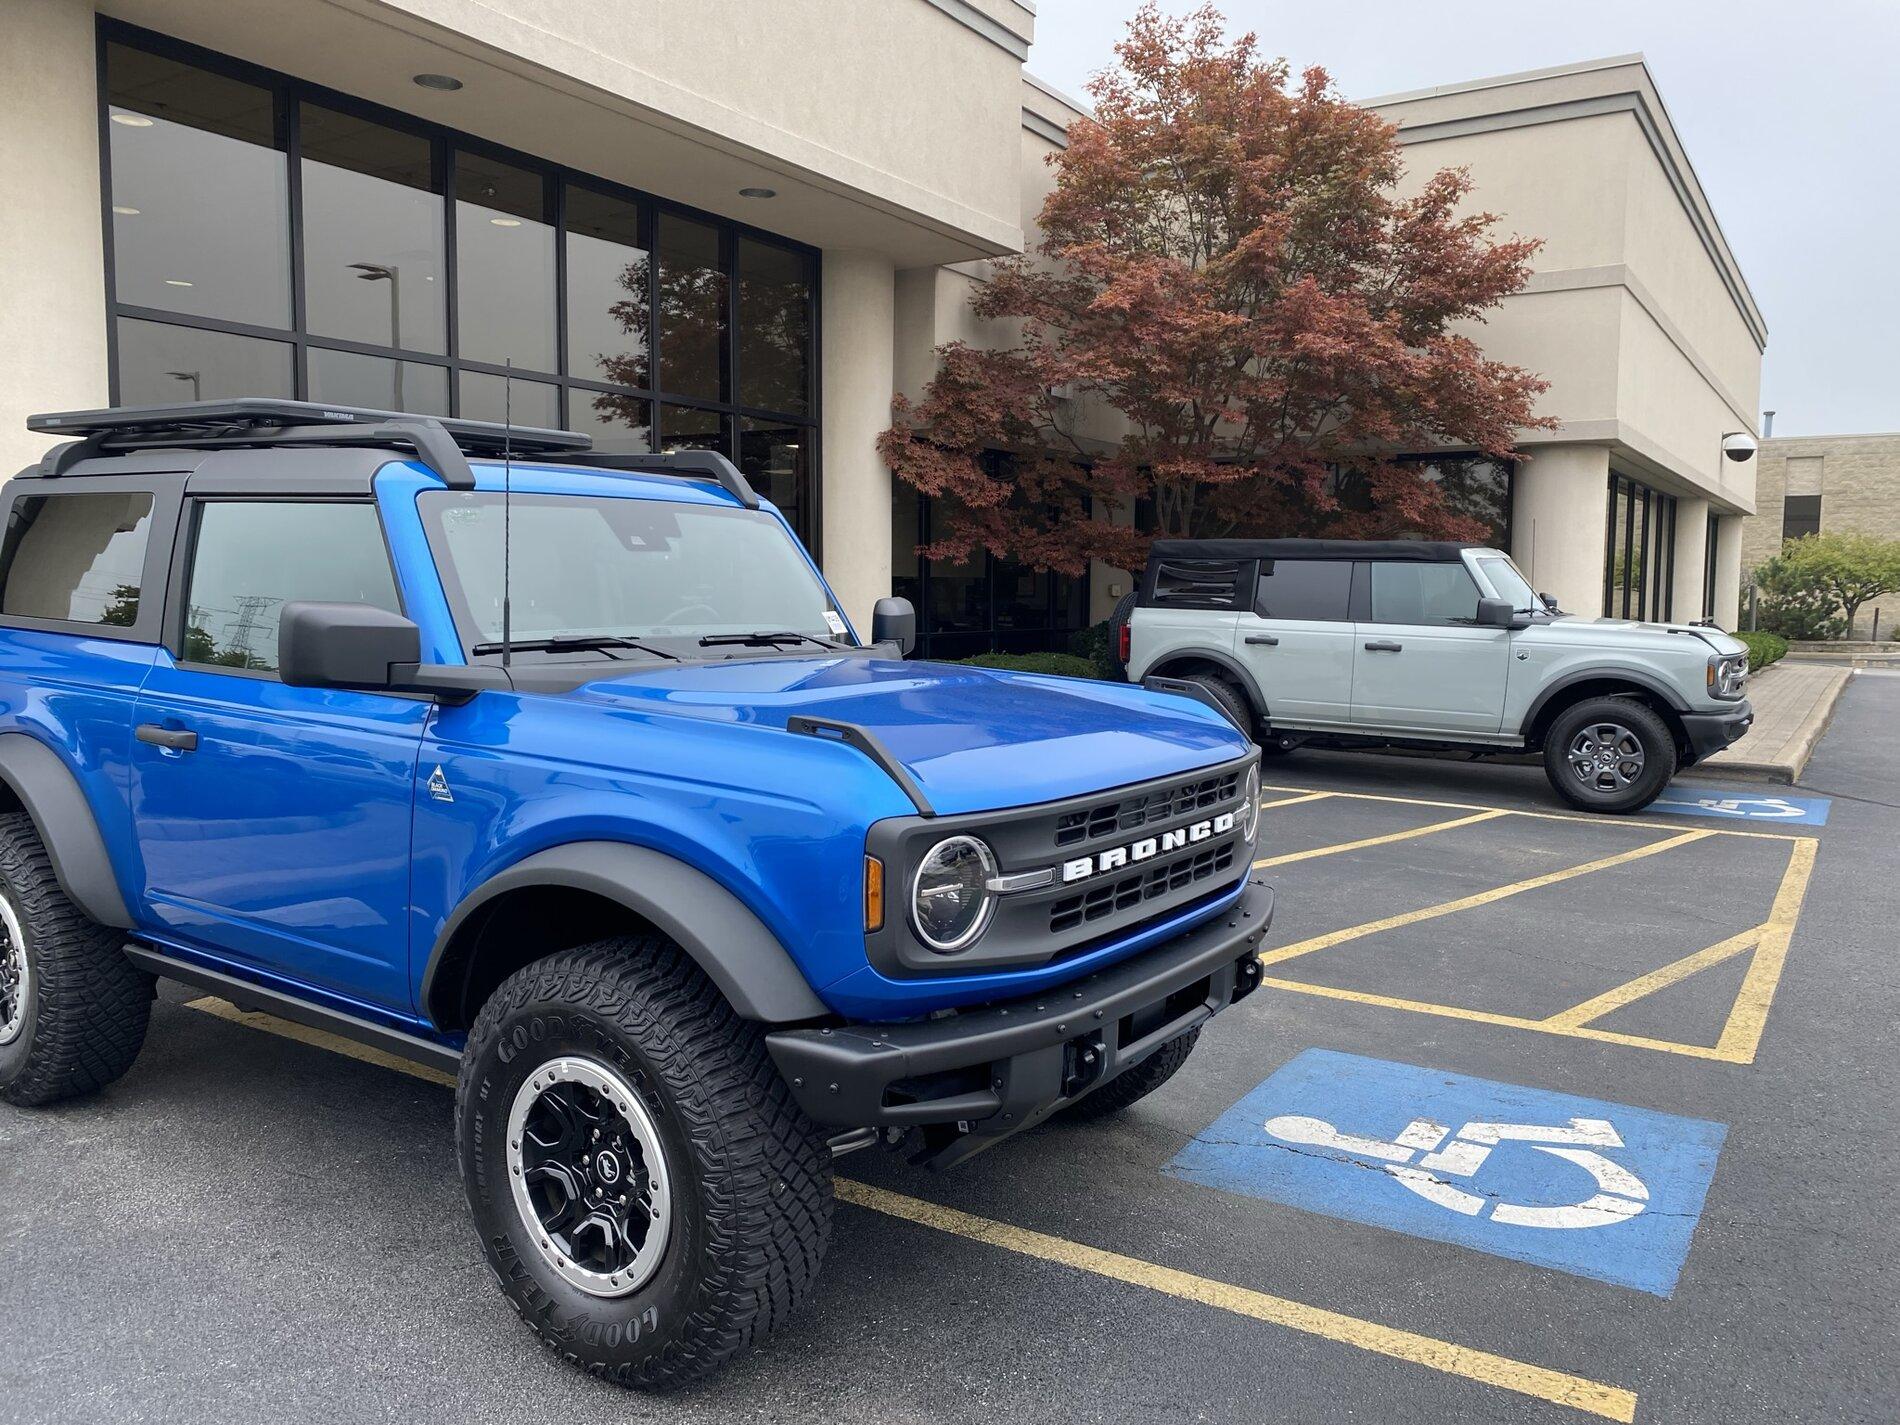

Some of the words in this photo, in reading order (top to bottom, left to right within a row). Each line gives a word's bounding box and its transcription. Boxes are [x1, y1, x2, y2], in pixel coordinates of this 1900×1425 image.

[323, 411, 354, 421] YAKIMA
[1063, 813, 1233, 882] BRONCO
[491, 1232, 659, 1348] GOODYEAR
